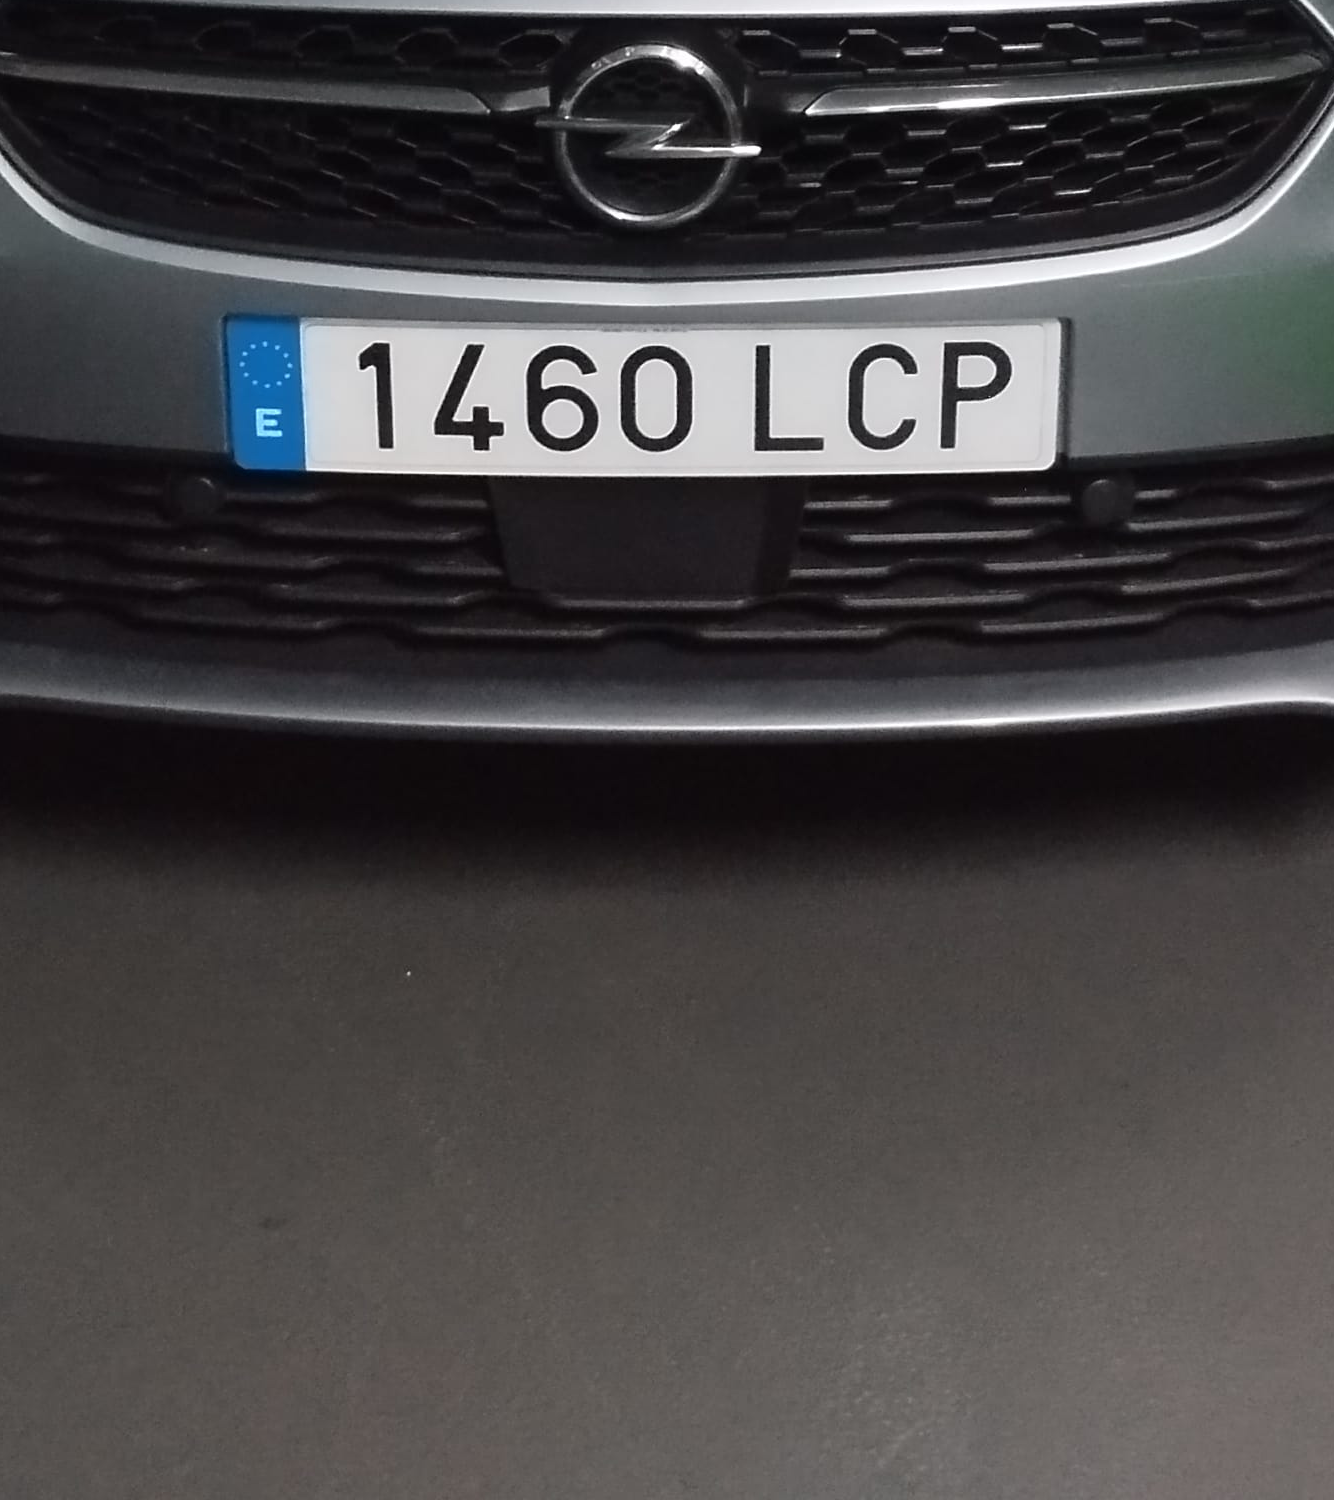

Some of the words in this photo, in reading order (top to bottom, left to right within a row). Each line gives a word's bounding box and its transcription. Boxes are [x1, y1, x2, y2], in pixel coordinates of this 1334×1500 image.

[255, 407, 284, 438] E
[357, 341, 693, 453] 1460
[753, 340, 1014, 452] LCP
